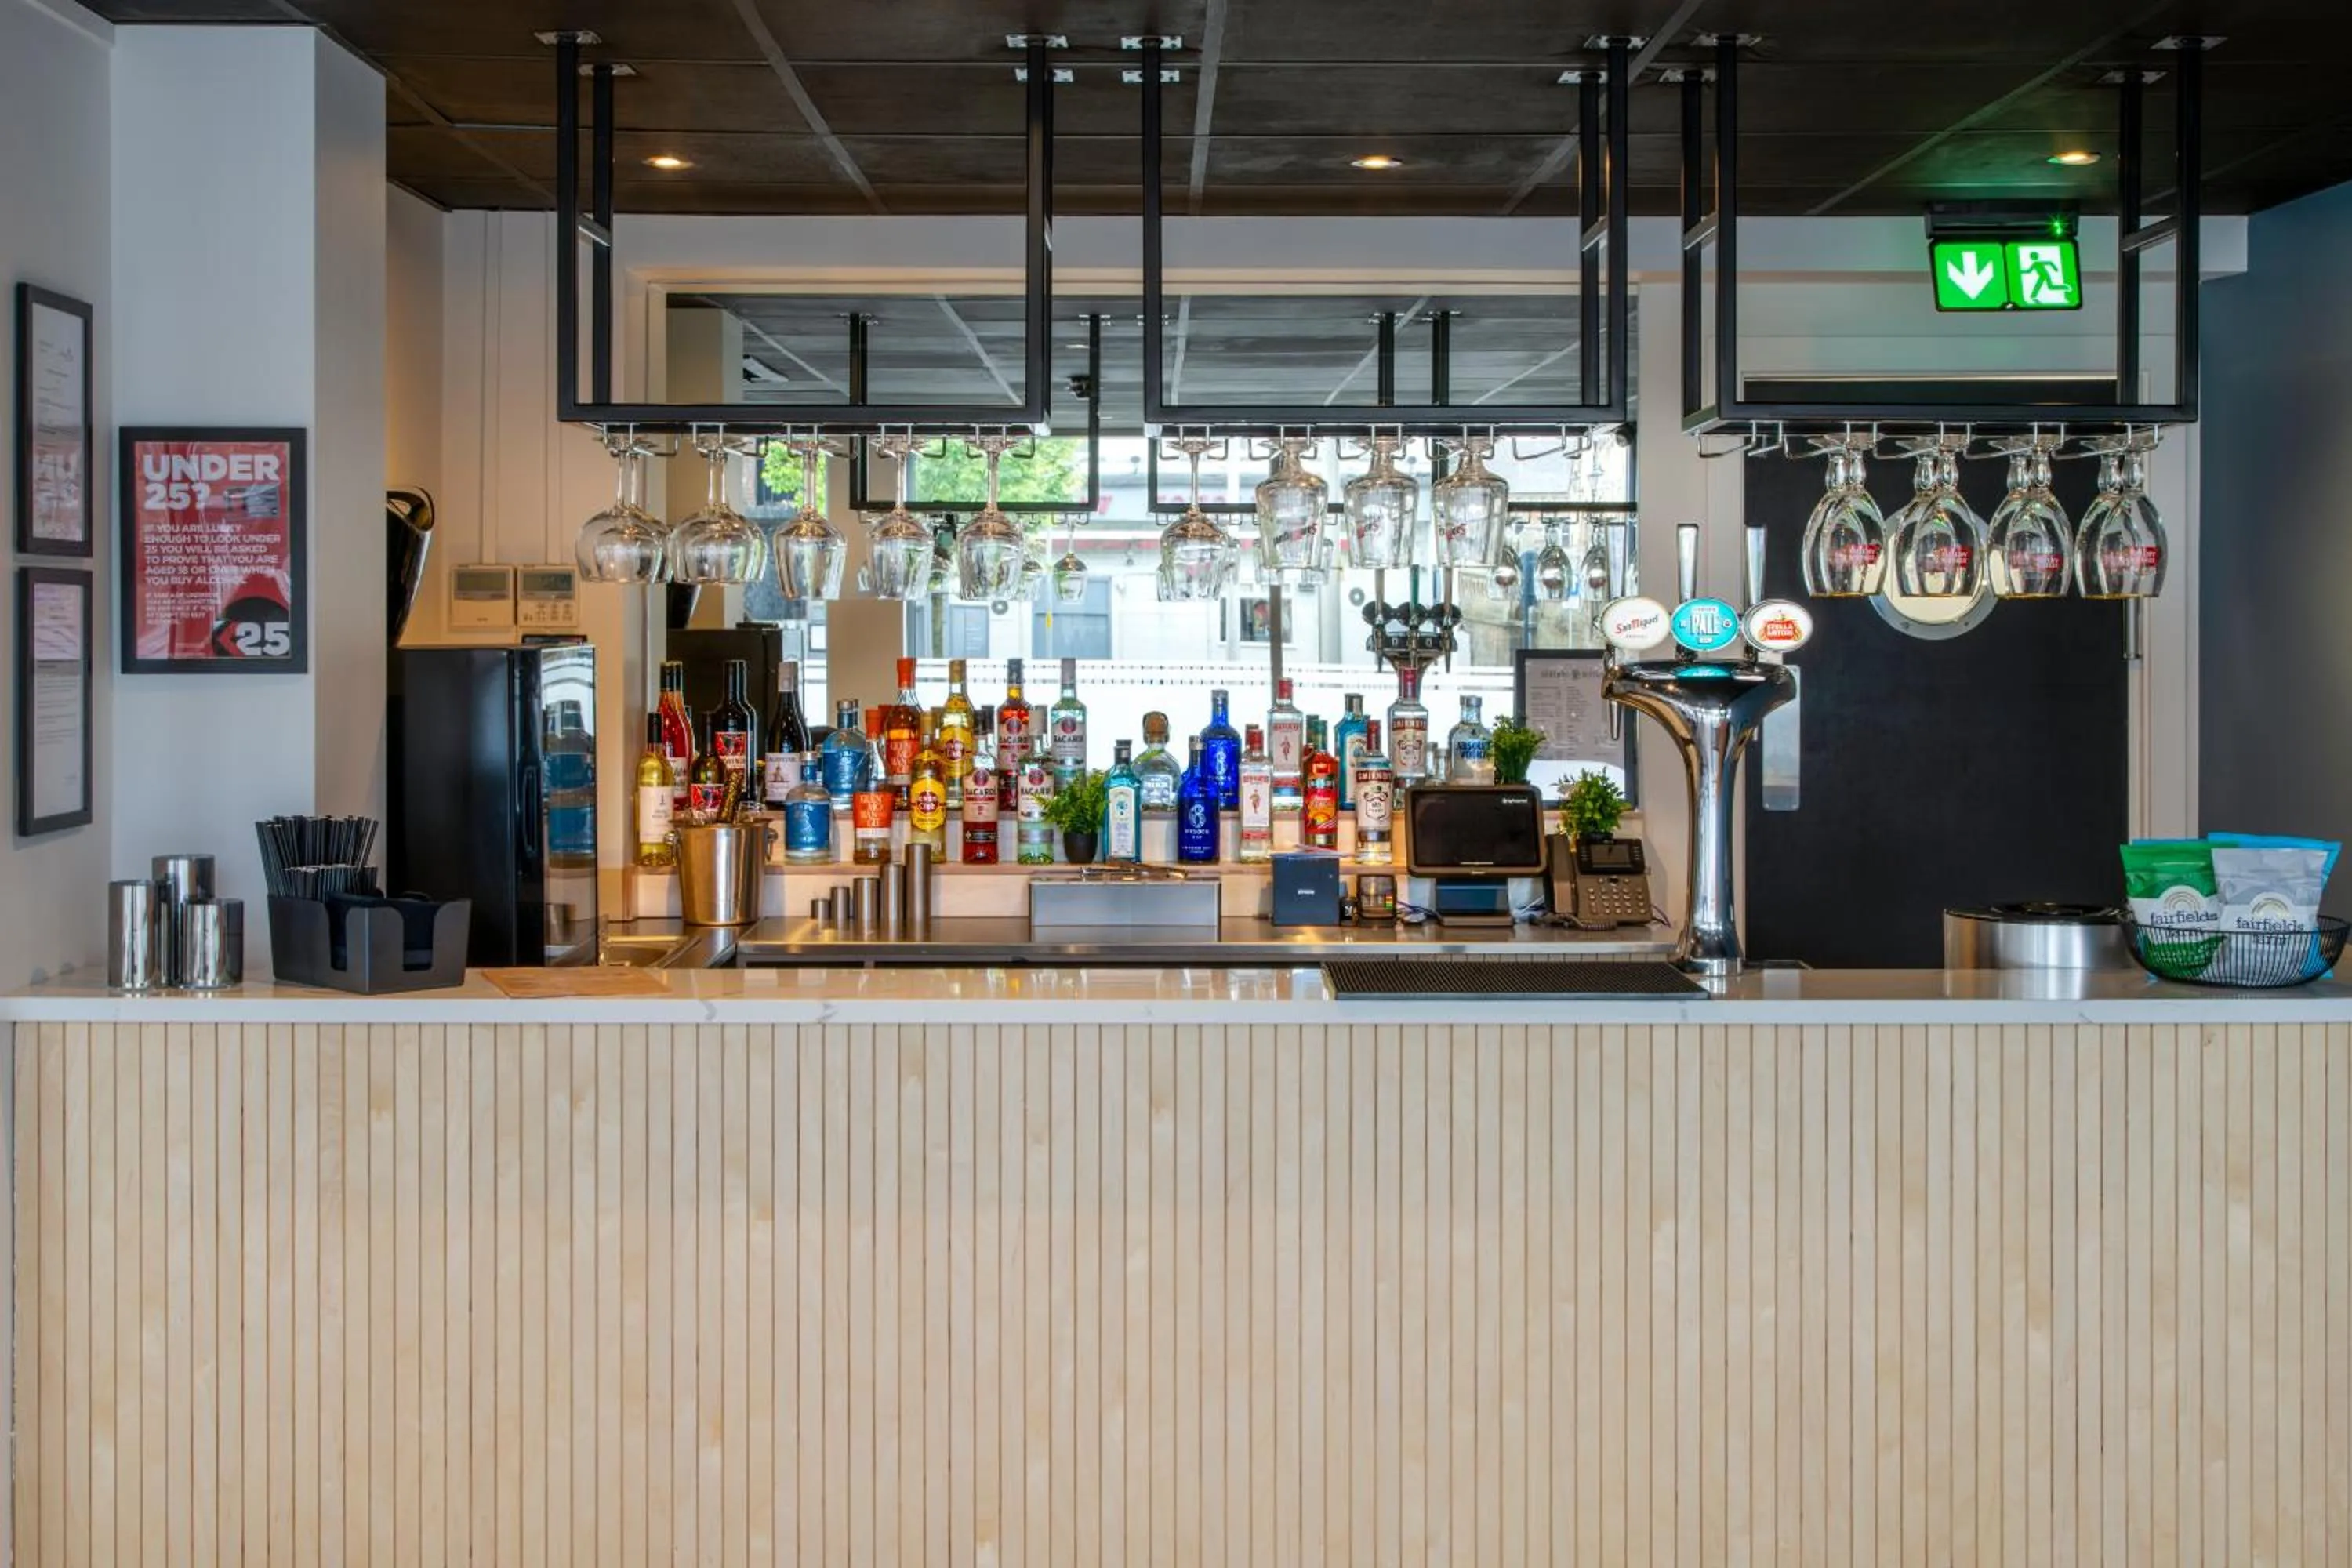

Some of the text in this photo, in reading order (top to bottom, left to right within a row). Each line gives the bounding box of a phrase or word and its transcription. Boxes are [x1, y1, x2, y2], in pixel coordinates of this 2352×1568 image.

[143, 454, 279, 481] UNDER
[144, 483, 211, 510] 25?
[158, 524, 180, 533] YOU
[182, 524, 204, 533] ARE
[206, 524, 242, 533] LUCKY
[144, 535, 191, 543] ENOUGH
[211, 534, 240, 543] LOOK
[242, 534, 281, 543] UNDER
[145, 544, 267, 554] 25 YOU WILL BE ASKED
[145, 555, 278, 564] TO PROVE THAT YOU ARE
[146, 565, 277, 575] AGED 18 OR OVER WHEN
[146, 576, 168, 585] YOU
[170, 576, 192, 585] BUY
[1691, 613, 1719, 636] PALE
[236, 622, 291, 656] 25
[2150, 911, 2218, 926] fairfields
[2236, 917, 2304, 932] fairfields
